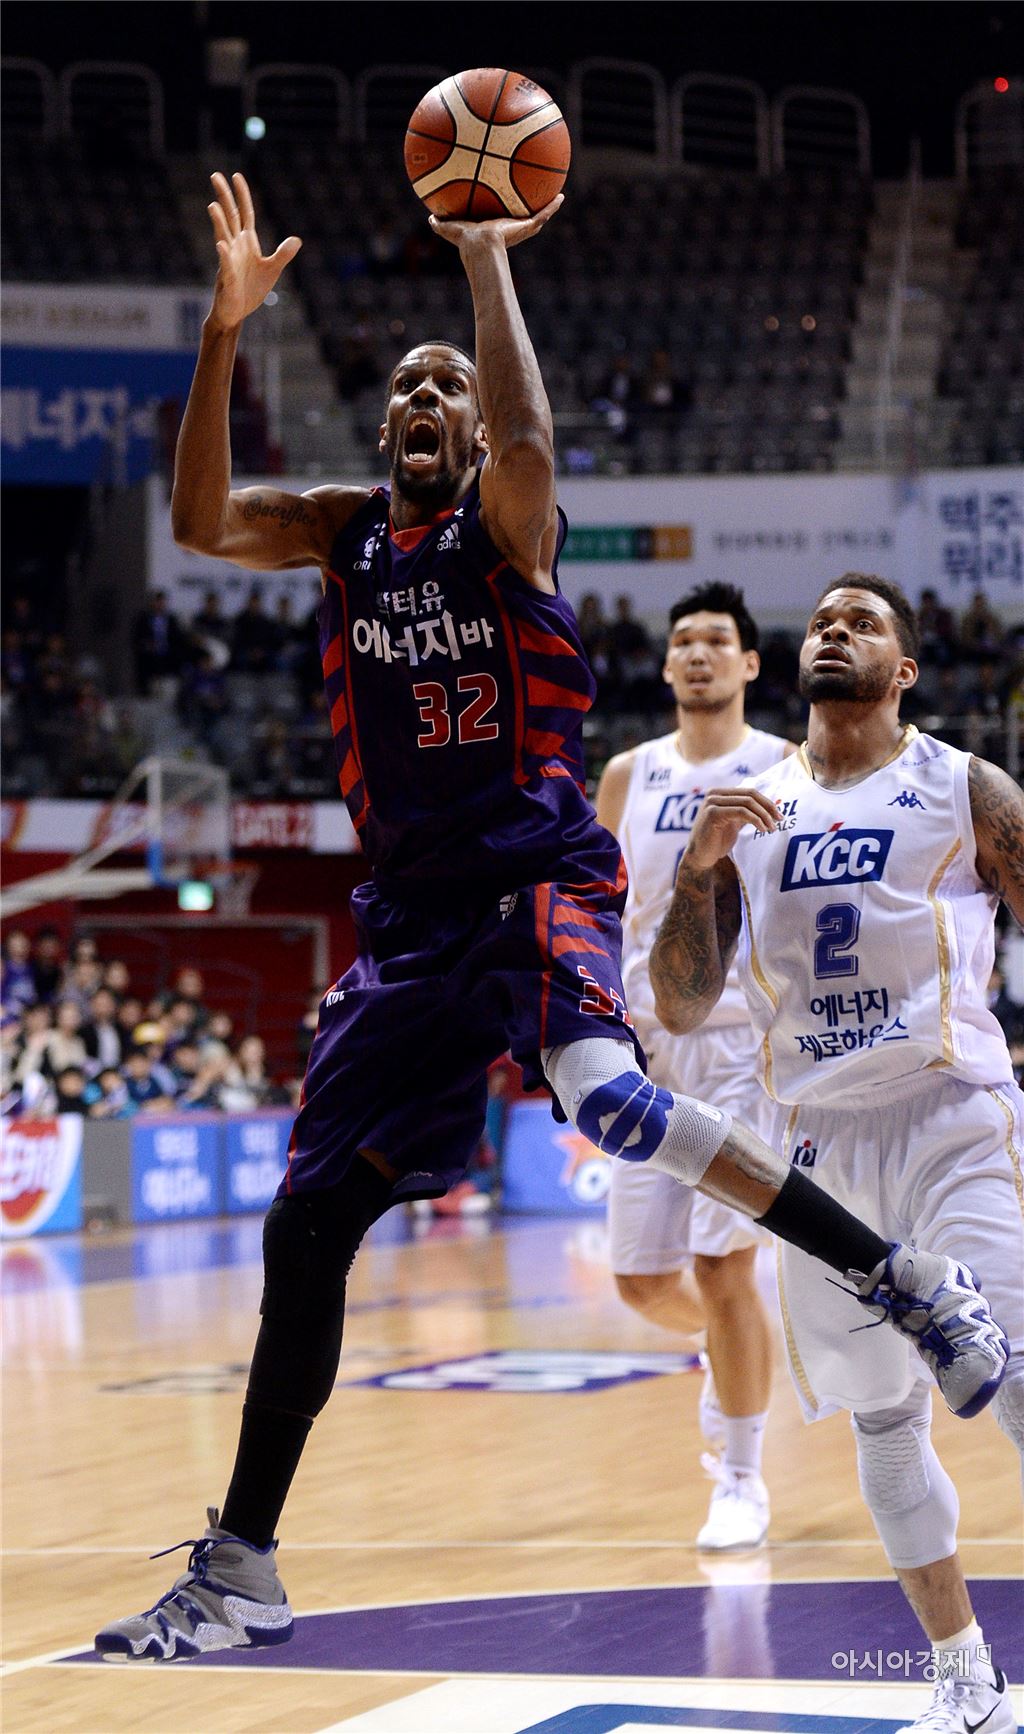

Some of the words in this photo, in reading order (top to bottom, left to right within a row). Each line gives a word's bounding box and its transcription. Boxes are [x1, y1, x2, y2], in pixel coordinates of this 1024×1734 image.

[352, 609, 495, 667] 에너지바
[412, 672, 499, 748] 32
[790, 822, 882, 884] KCC
[814, 902, 861, 980] 2
[810, 988, 889, 1027] 에너지
[794, 1016, 910, 1062] 제로하우스
